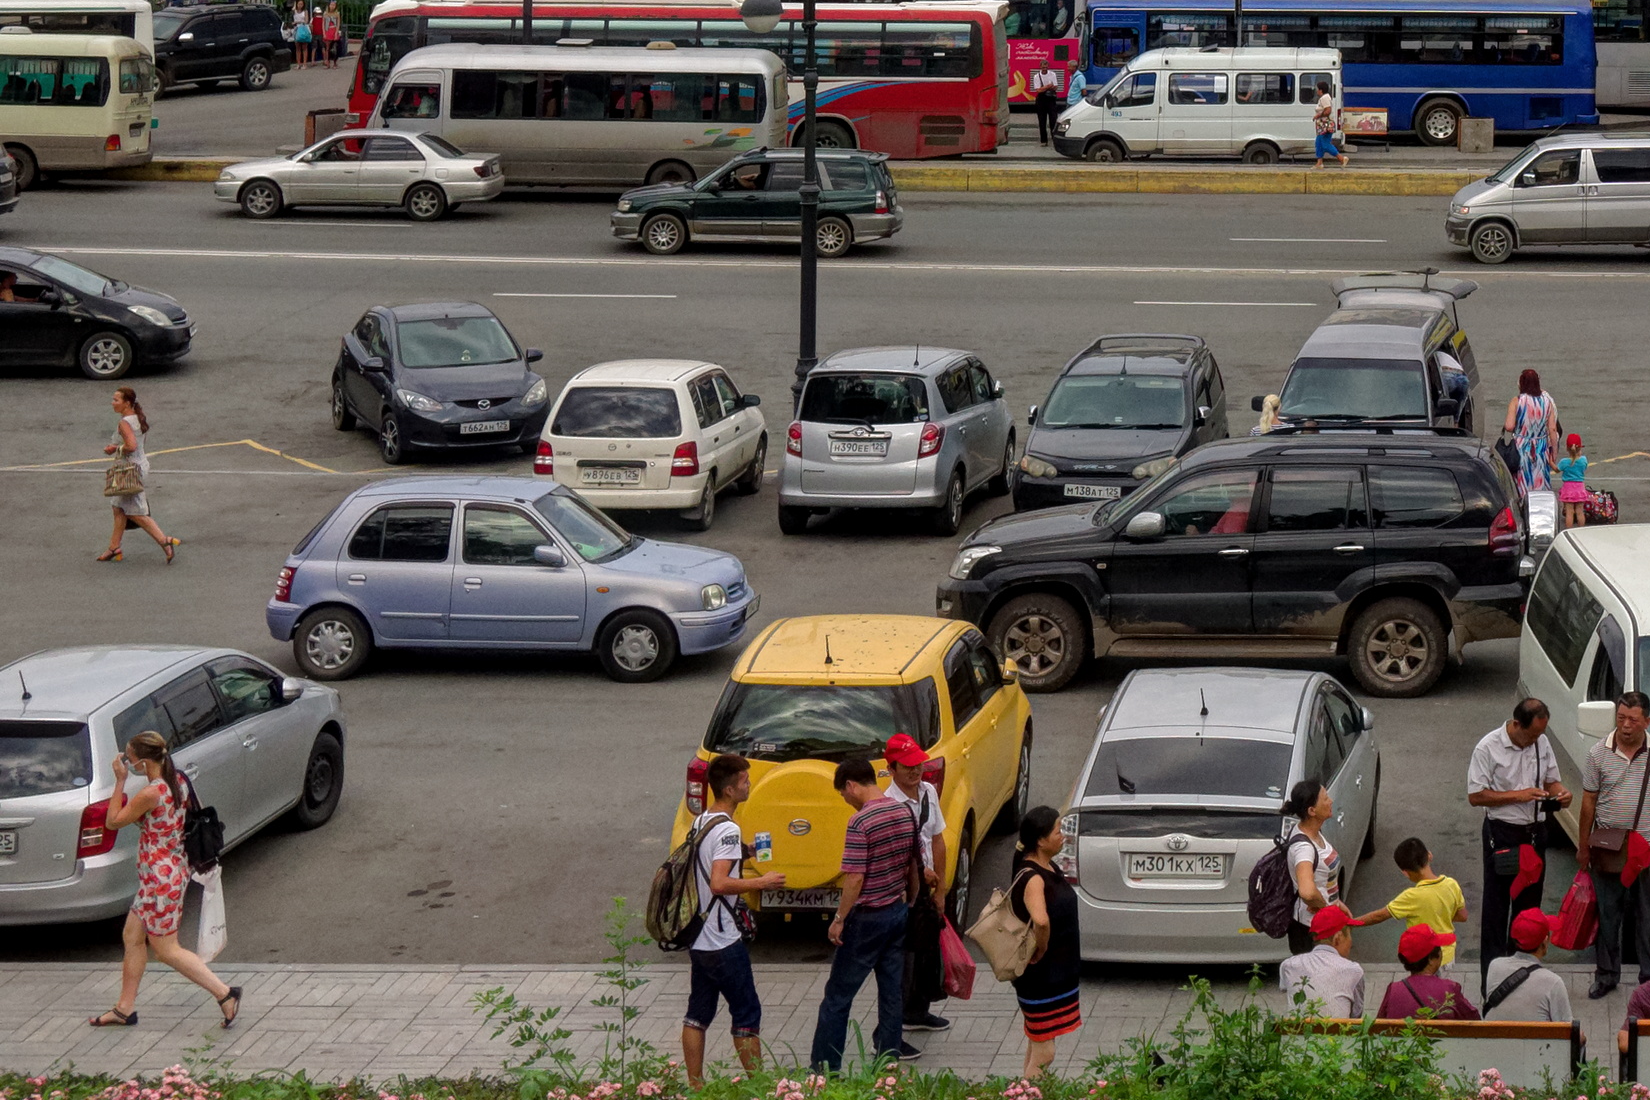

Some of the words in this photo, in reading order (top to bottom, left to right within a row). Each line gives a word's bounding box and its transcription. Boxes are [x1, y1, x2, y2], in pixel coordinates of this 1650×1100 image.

[463, 422, 496, 433] Т662АН
[497, 421, 509, 430] 125
[833, 443, 869, 453] Н390ЕЕ
[872, 441, 885, 451] 125
[586, 470, 622, 480] У896ЕВ
[625, 470, 639, 478] 125
[1066, 486, 1103, 496] М138АТ
[1105, 488, 1119, 496] 125
[1136, 855, 1195, 874] М301КХ
[1197, 855, 1218, 870] 125
[766, 889, 825, 905] У934КМ
[826, 889, 842, 903] 12
